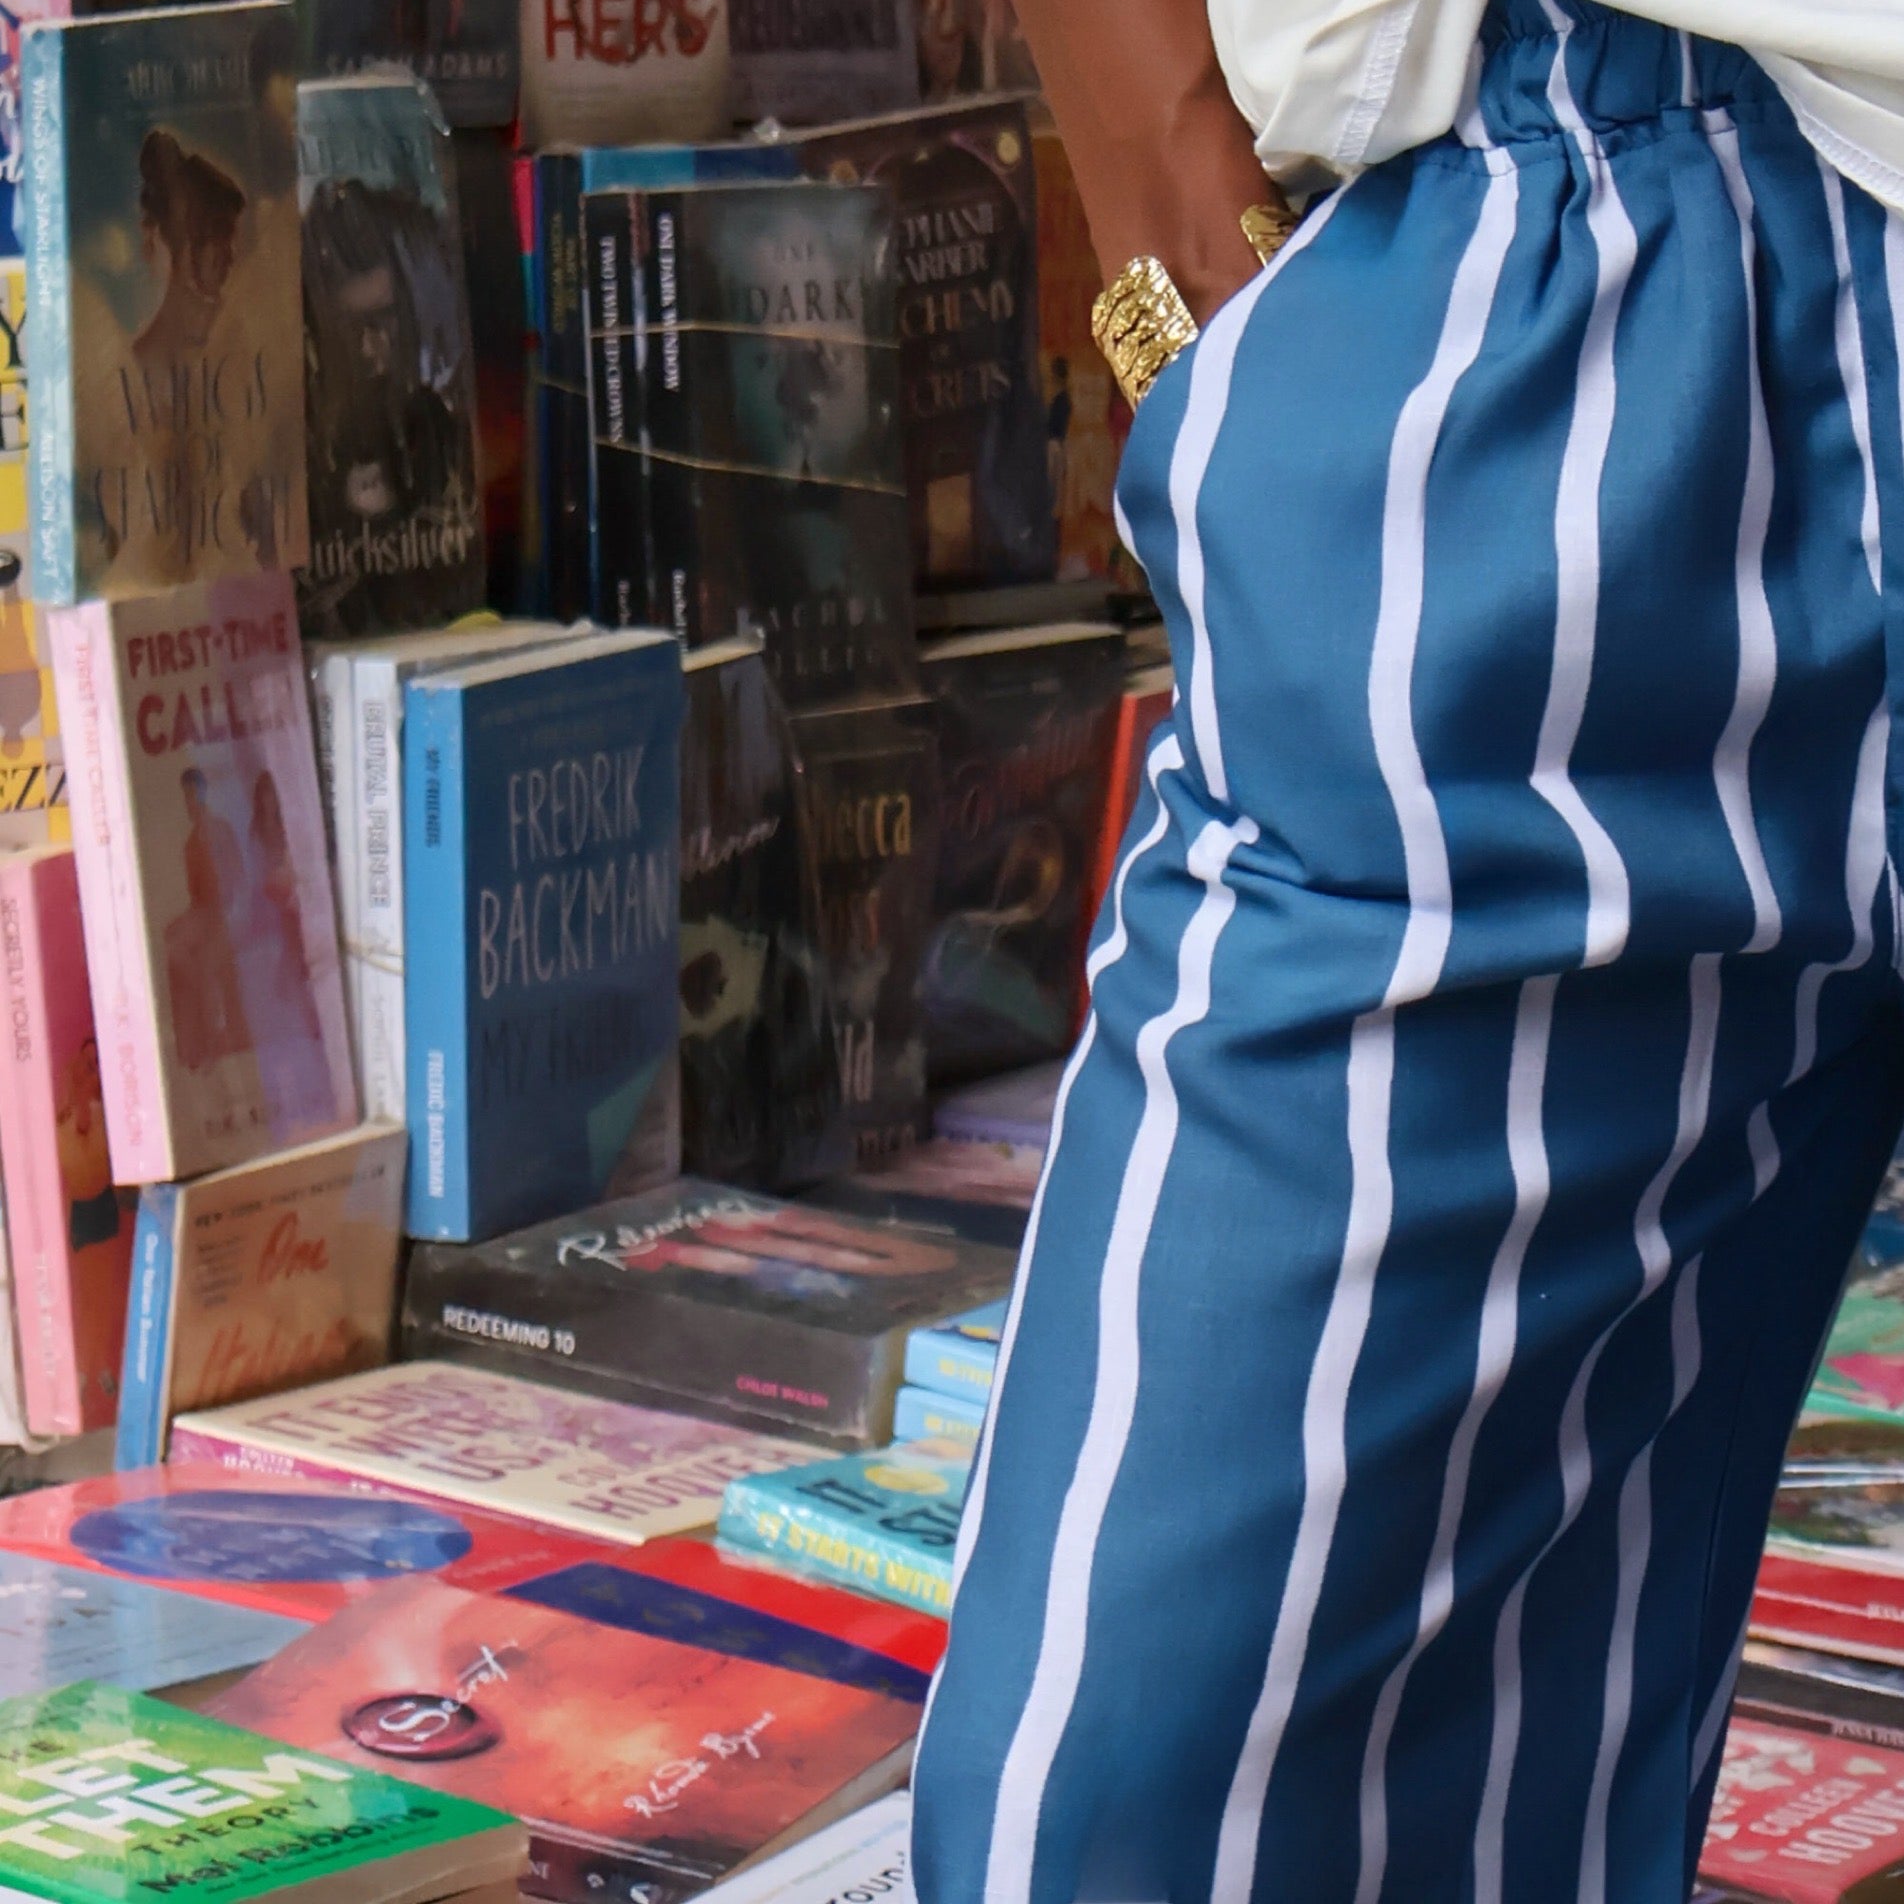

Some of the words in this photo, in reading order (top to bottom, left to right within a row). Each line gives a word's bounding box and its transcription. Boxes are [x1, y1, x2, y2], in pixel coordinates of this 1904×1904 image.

[31, 77, 48, 153] WINGS
[34, 191, 52, 308] STARLIGHT
[751, 287, 857, 326] DARK
[127, 611, 289, 681] FIRST-TIME
[362, 699, 388, 804] BRUTAL
[507, 744, 646, 872] FREDRIK
[367, 808, 393, 909] PRINCE
[478, 849, 671, 1000] BACKMAN
[10, 992, 33, 1063] YOURS
[442, 1304, 551, 1351] REDEEMING
[551, 1327, 576, 1356] 10
[735, 1374, 779, 1400] CHLOE
[756, 1512, 784, 1542] IT
[787, 1521, 881, 1580] STARTS
[0, 1751, 355, 1860] THEM
[132, 1795, 321, 1857] THEORY
[238, 1806, 440, 1867] Robbins
